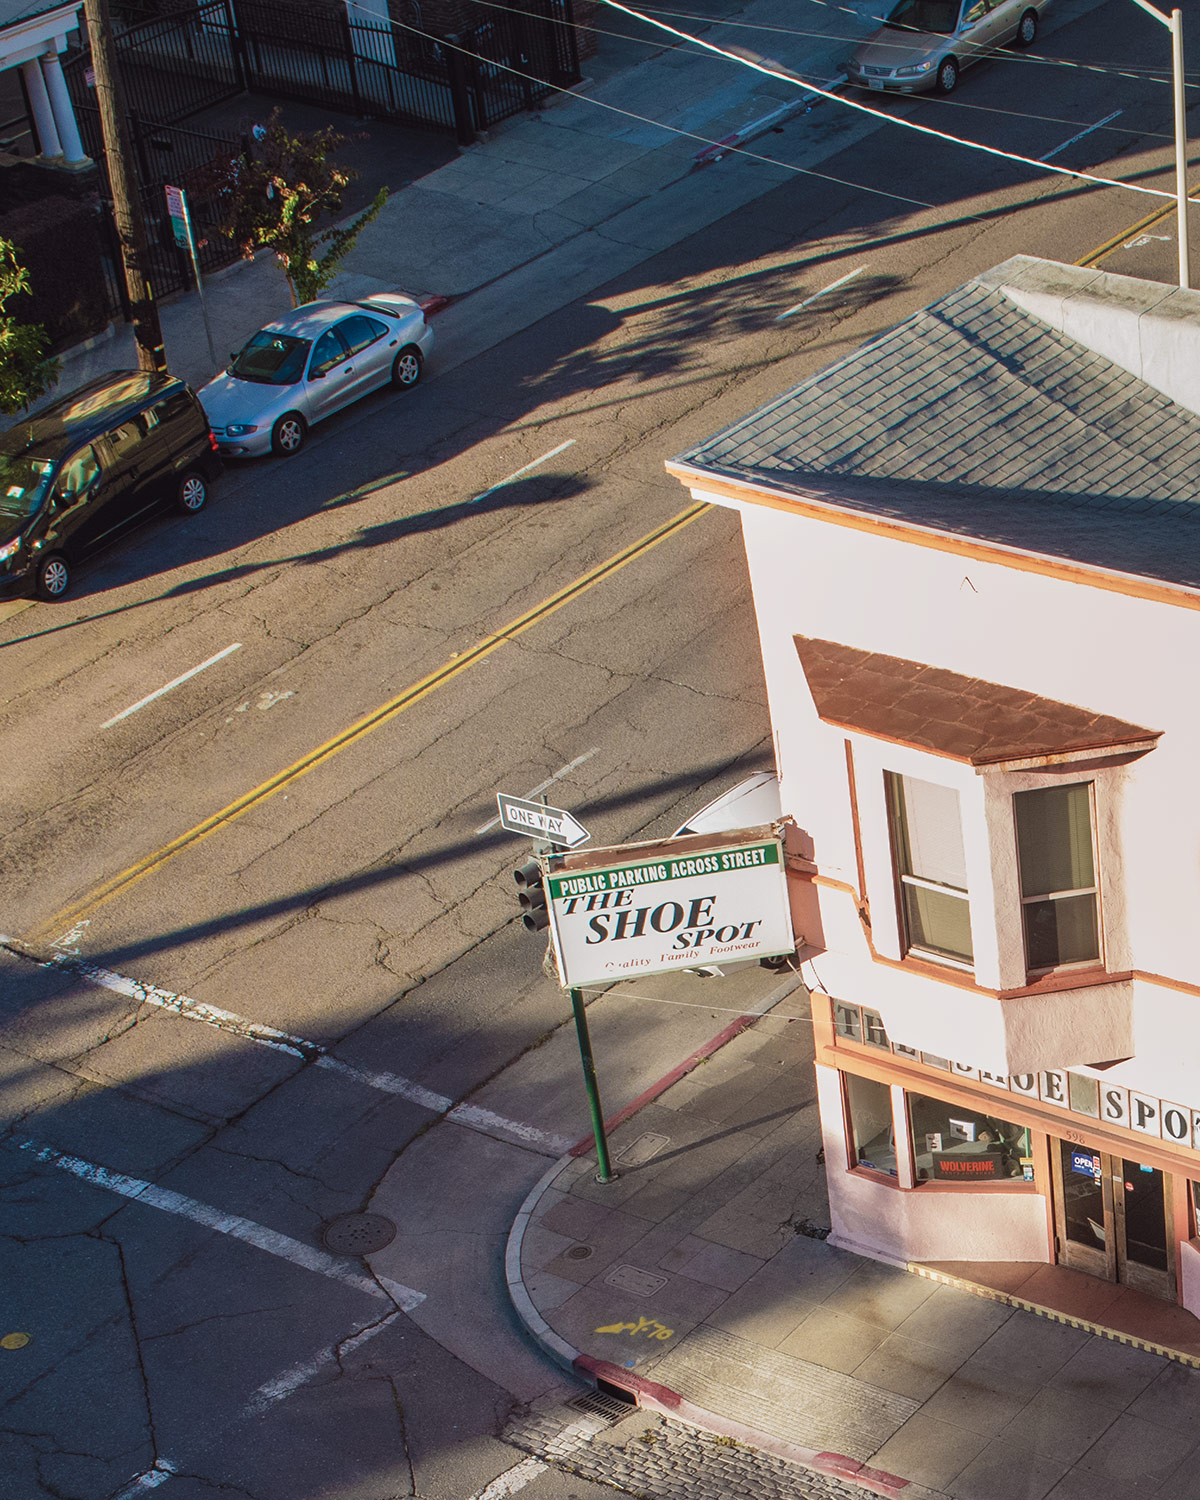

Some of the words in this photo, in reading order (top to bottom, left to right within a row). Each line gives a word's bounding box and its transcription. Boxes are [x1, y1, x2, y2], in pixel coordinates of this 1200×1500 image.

[510, 808, 535, 826] ONE
[538, 815, 562, 833] WAY
[559, 874, 606, 896] PUBLIC
[609, 864, 667, 888] PARKING
[671, 855, 719, 878] ACROSS
[721, 849, 766, 869] STREET
[562, 888, 635, 916] THE
[585, 895, 717, 945] SHOE
[672, 920, 762, 950] SPOT
[605, 958, 651, 972] Qality
[709, 941, 761, 955] Footwear
[939, 1160, 995, 1172] WOLVERINE
[1073, 1156, 1093, 1169] OPEN
